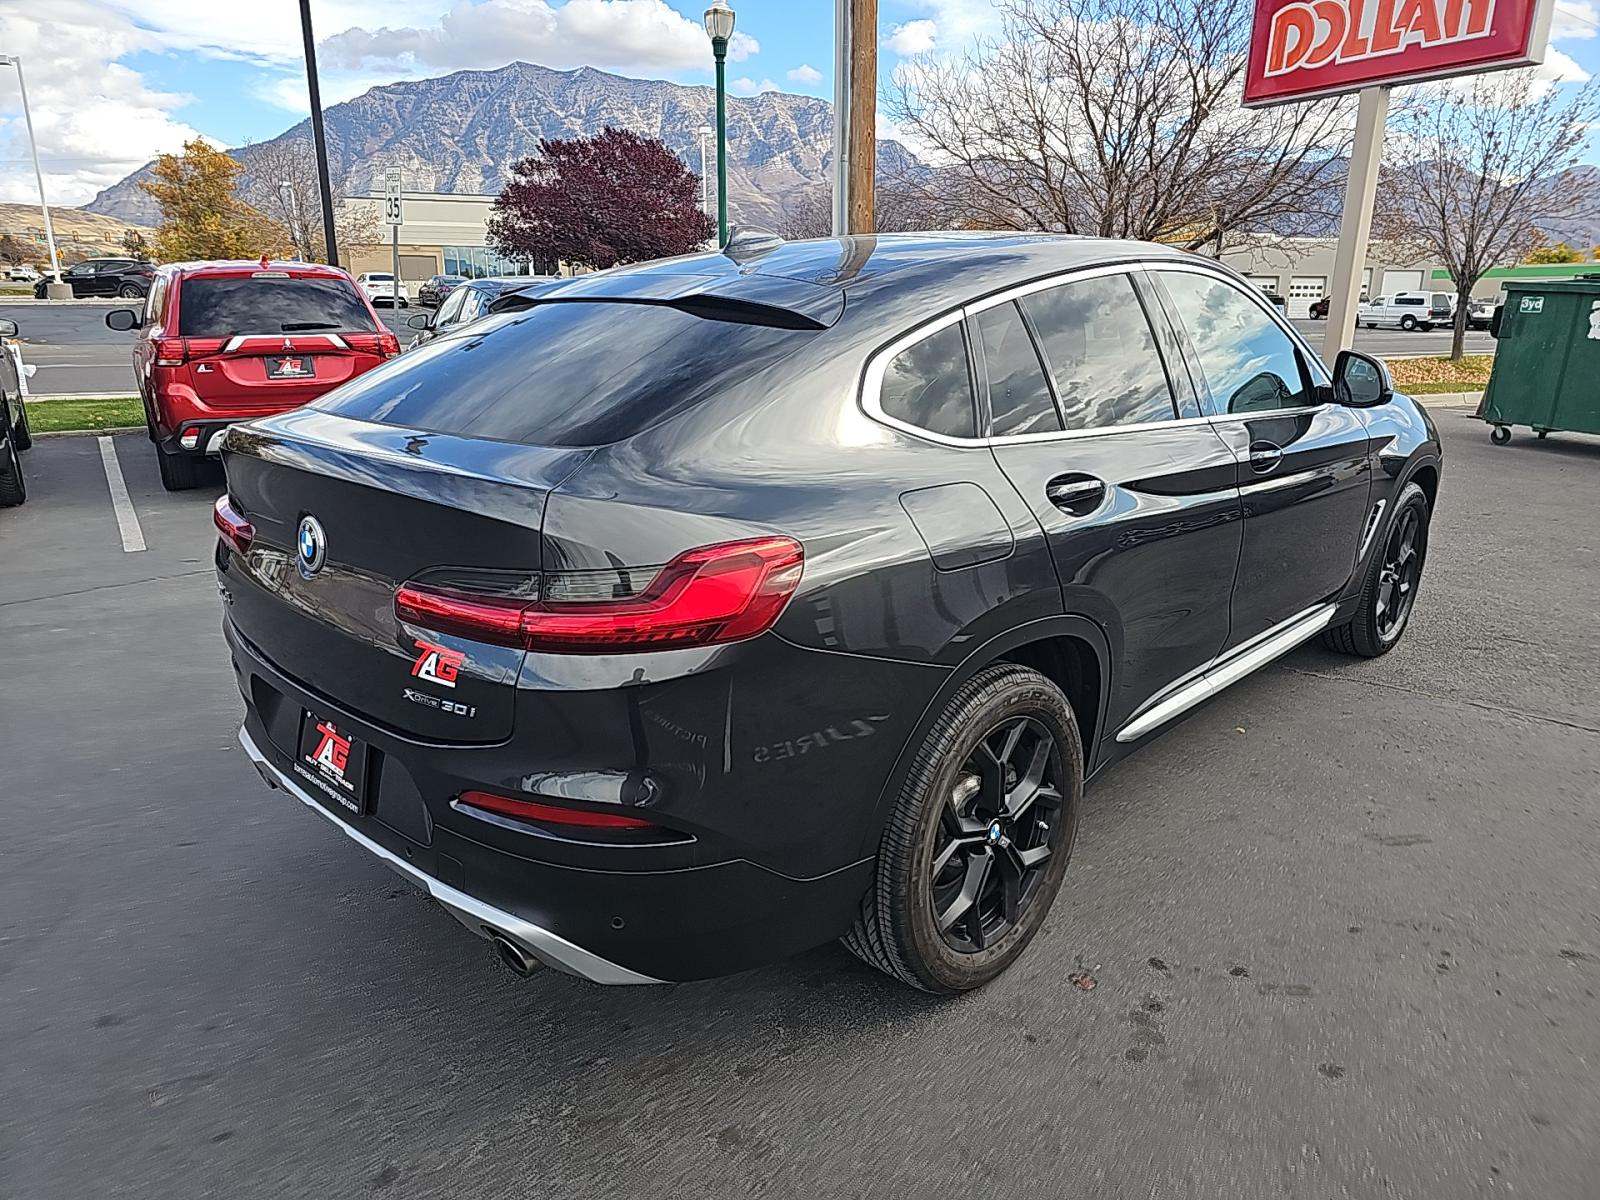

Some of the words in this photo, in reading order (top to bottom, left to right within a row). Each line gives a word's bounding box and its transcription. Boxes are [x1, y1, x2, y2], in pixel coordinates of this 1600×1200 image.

[387, 197, 400, 218] 35
[1521, 299, 1543, 310] 3yd
[410, 640, 466, 688] TAG
